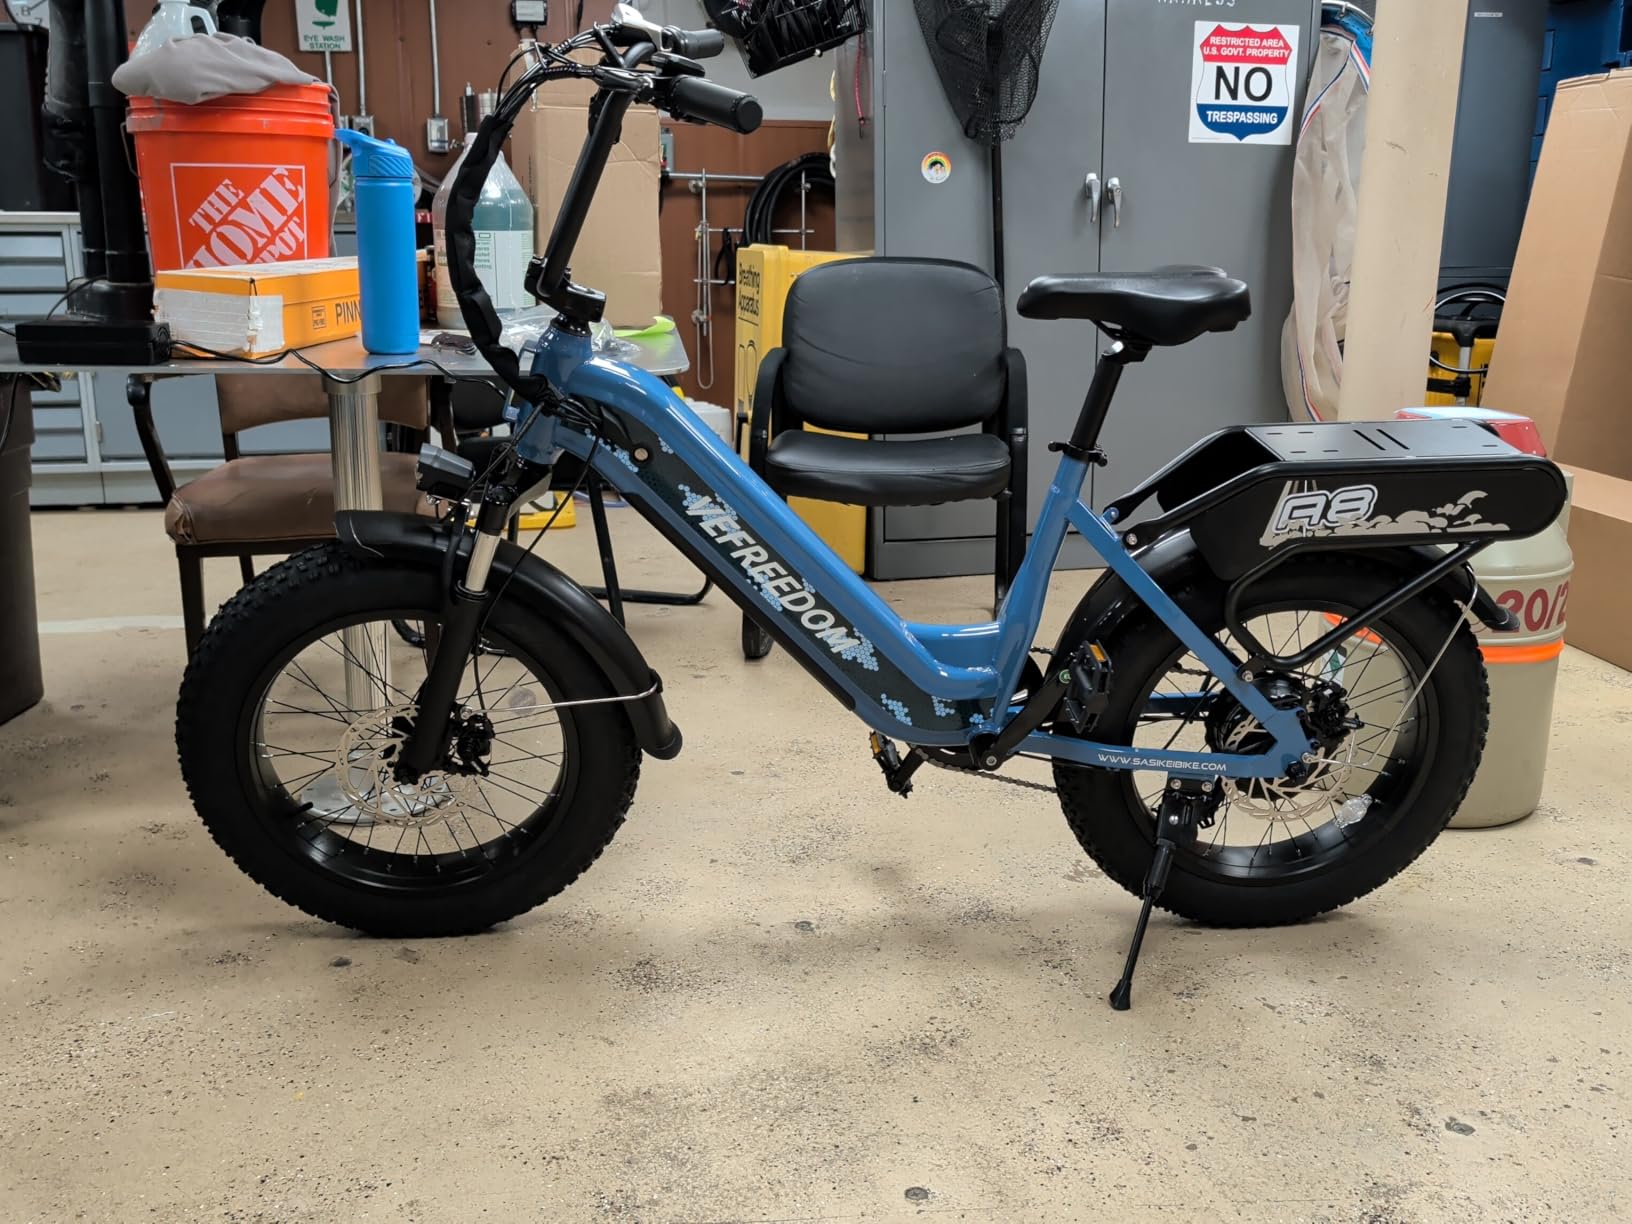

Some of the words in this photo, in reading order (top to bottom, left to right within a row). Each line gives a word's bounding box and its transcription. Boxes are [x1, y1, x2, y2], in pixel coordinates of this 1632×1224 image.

[303, 34, 319, 42] EYE
[322, 34, 345, 42] WASH
[1210, 36, 1261, 47] RESTRICTED
[1262, 38, 1285, 48] AREA
[1203, 46, 1219, 55] U.S.
[1220, 47, 1245, 56] GOVT.
[1246, 49, 1290, 58] PROPERTY
[1214, 65, 1273, 102] NO
[1206, 110, 1278, 124] TRESPASSING
[188, 178, 245, 234] THE
[739, 261, 760, 295] Breathing
[738, 290, 759, 317] Apparatus
[1272, 484, 1378, 534] A8
